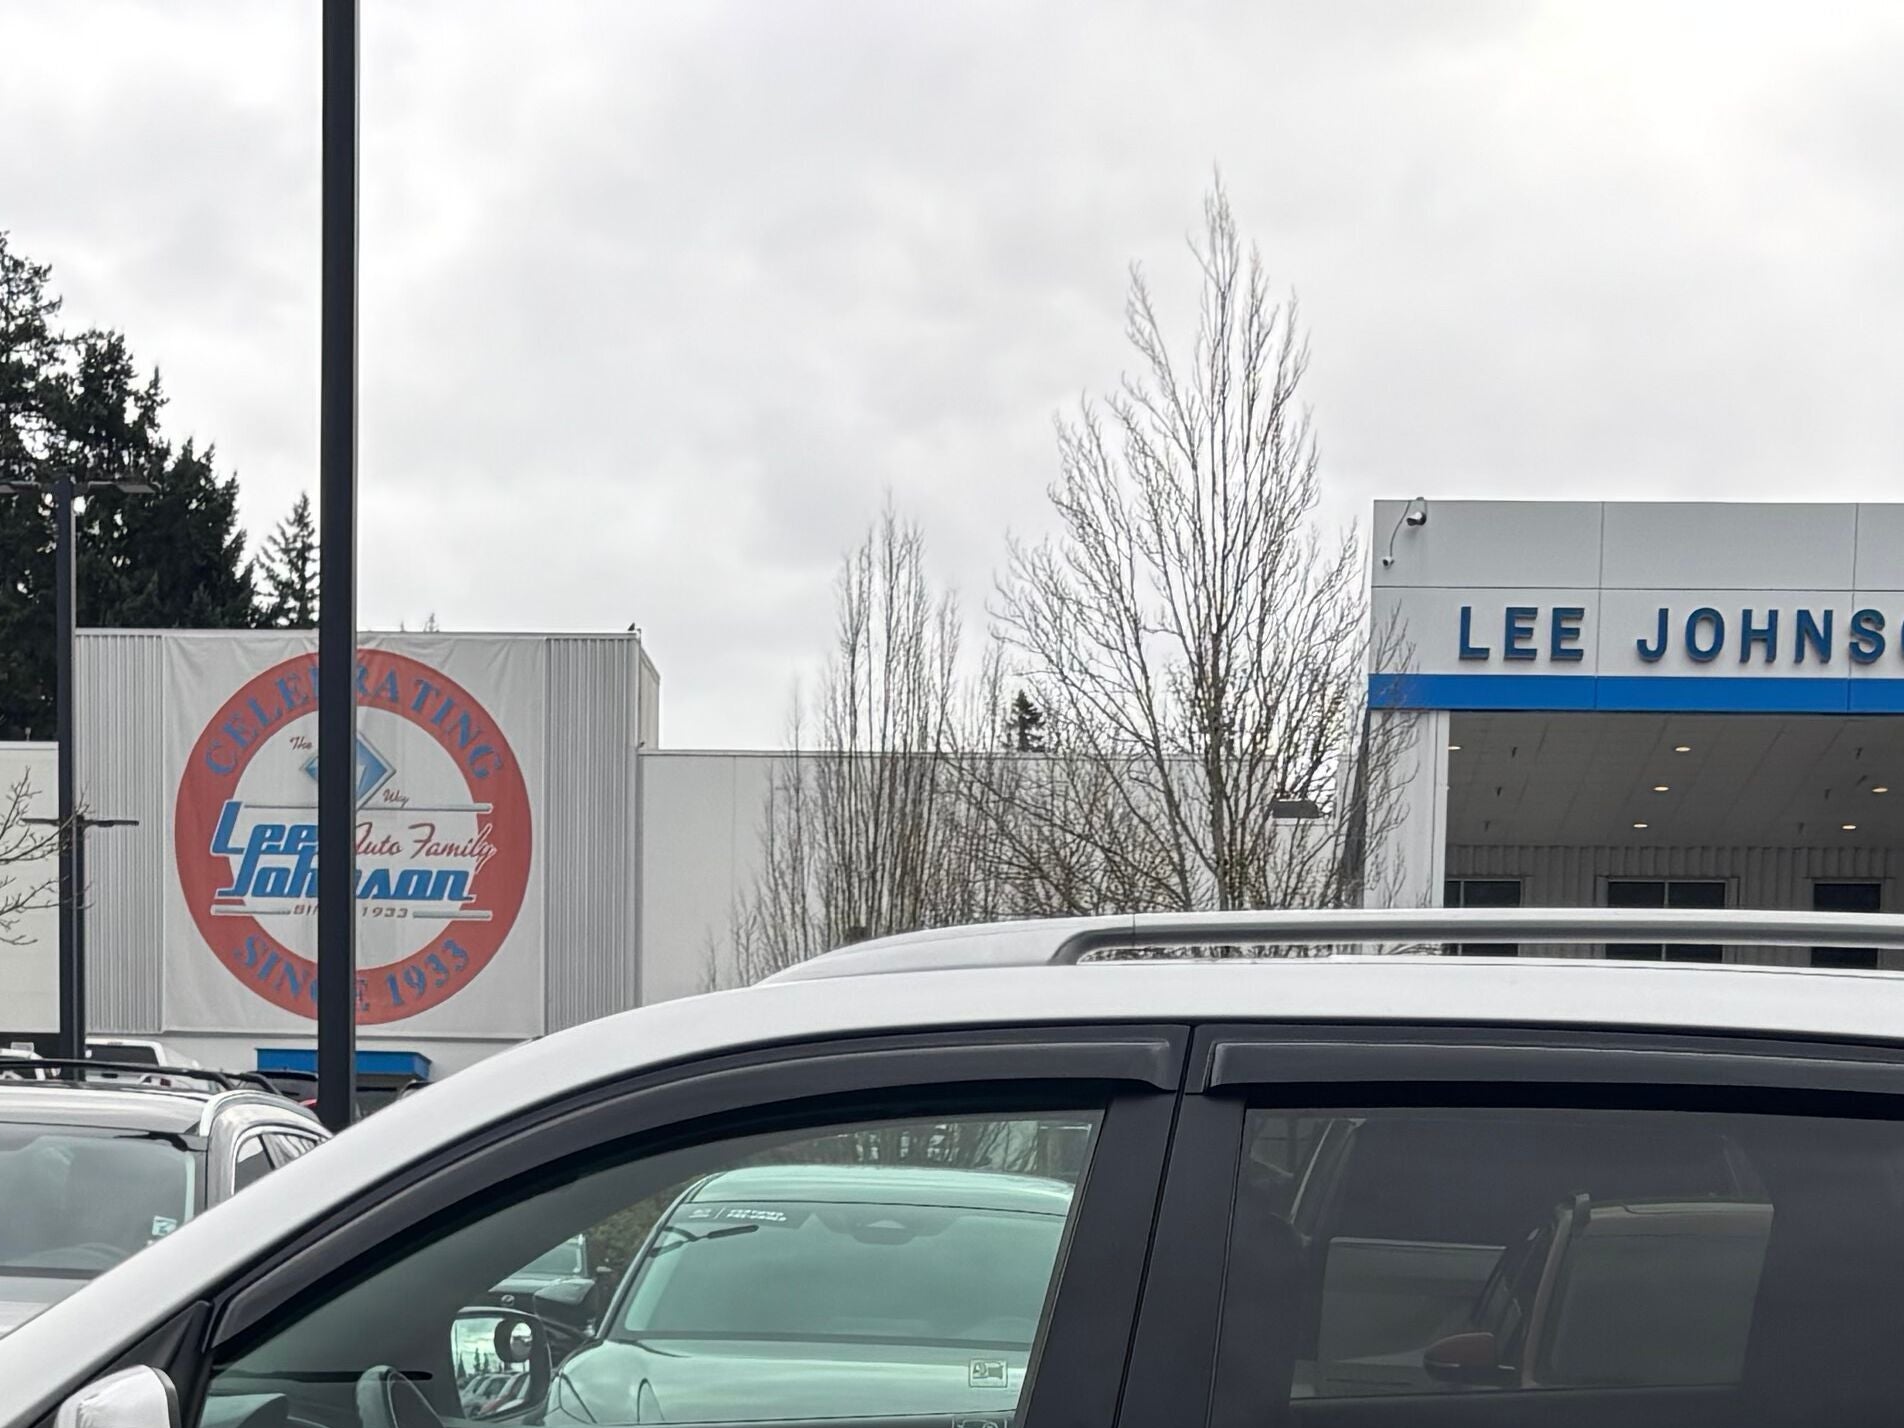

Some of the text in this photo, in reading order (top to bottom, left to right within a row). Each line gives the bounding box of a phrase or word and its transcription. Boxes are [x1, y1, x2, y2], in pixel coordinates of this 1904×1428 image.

[1459, 606, 1585, 663] LEE
[203, 662, 503, 781] CELERATING
[210, 800, 319, 856] Lee
[407, 822, 497, 872] Family
[217, 848, 475, 901] Johson
[362, 906, 408, 919] 1933
[232, 933, 471, 1012] SINE 1933
